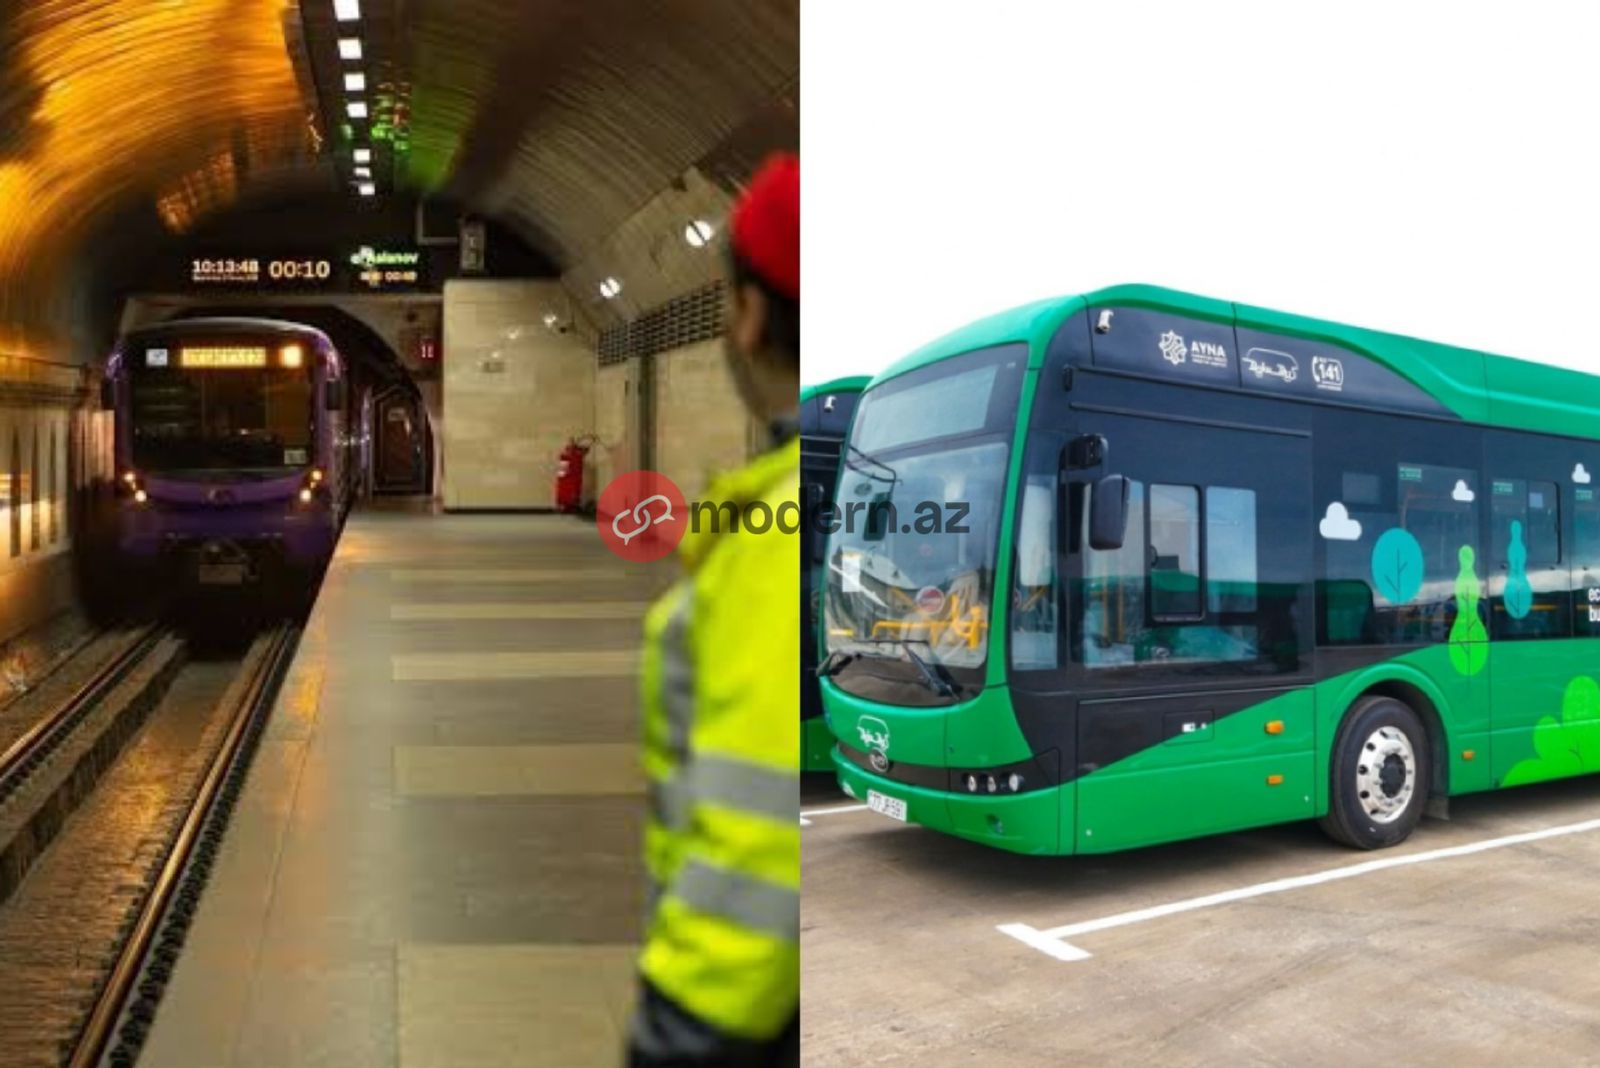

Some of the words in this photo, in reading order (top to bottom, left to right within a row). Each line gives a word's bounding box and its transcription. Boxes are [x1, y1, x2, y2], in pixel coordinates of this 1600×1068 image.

[269, 260, 331, 279] 00:10
[1191, 340, 1226, 357] AYNA
[1319, 363, 1341, 381] 141
